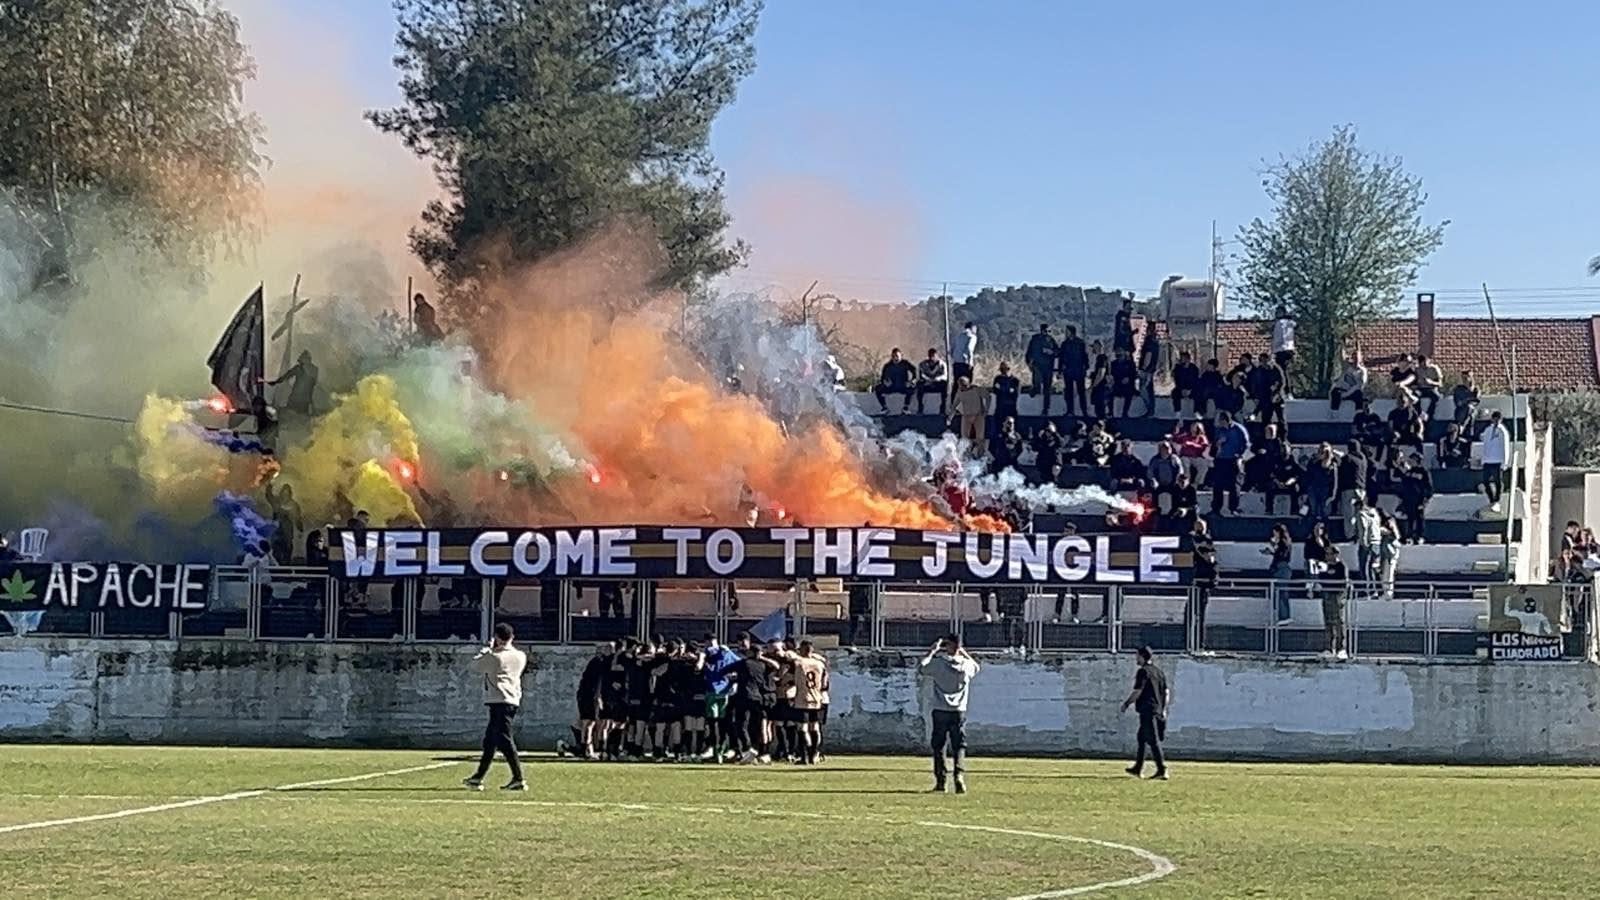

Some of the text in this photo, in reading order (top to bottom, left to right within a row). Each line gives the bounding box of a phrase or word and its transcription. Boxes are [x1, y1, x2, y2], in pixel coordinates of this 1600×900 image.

[340, 528, 1181, 584] WELCOME TO THE JUNGLE
[43, 562, 210, 609] APACHE
[1492, 633, 1520, 646] LOS
[1492, 646, 1559, 660] CUADRADO
